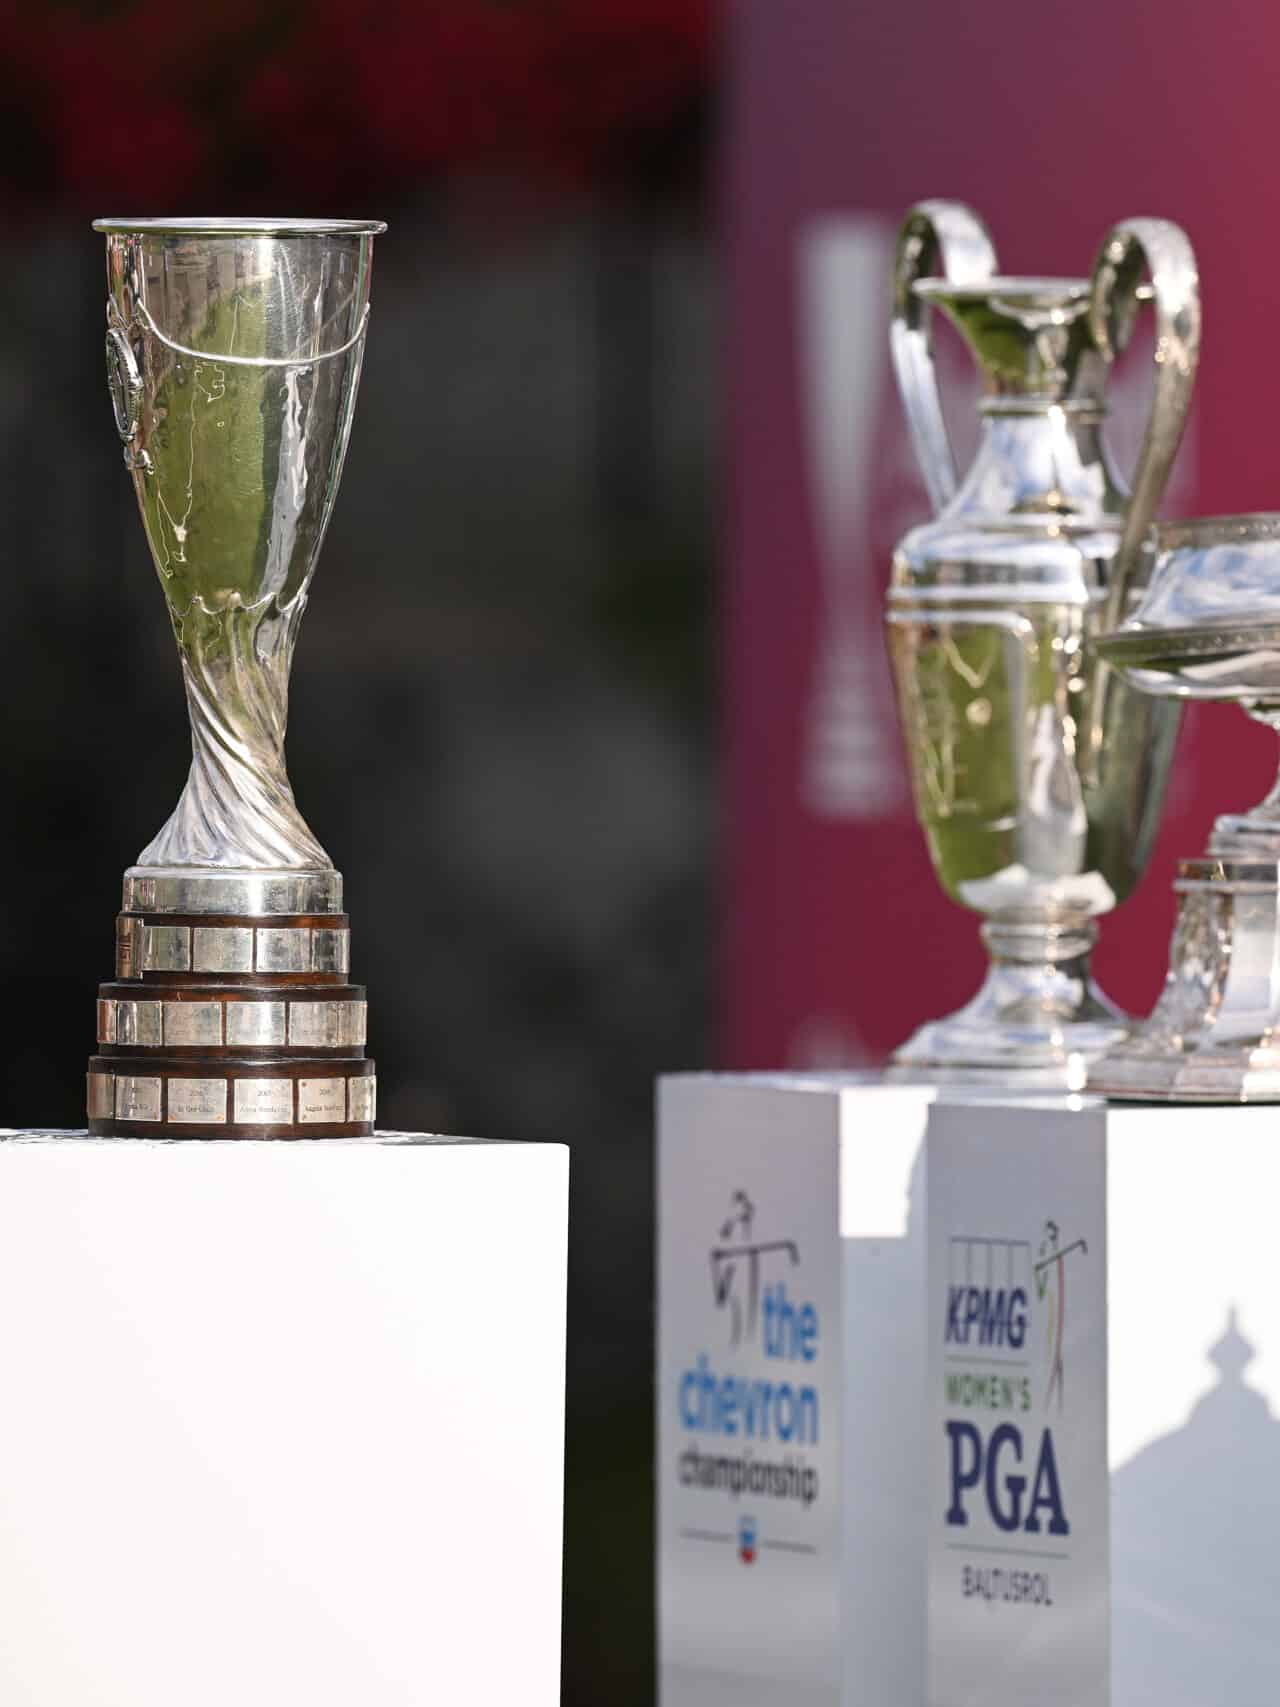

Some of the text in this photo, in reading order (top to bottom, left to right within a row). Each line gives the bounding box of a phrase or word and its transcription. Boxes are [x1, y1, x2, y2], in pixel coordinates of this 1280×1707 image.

[763, 1285, 818, 1361] the
[945, 1286, 1027, 1348] KPMG
[679, 1355, 818, 1443] chevron
[946, 1374, 1030, 1411] WOMEN'S
[679, 1444, 818, 1508] championship
[945, 1420, 1070, 1535] PGA
[962, 1567, 1053, 1606] BALTUSROL
